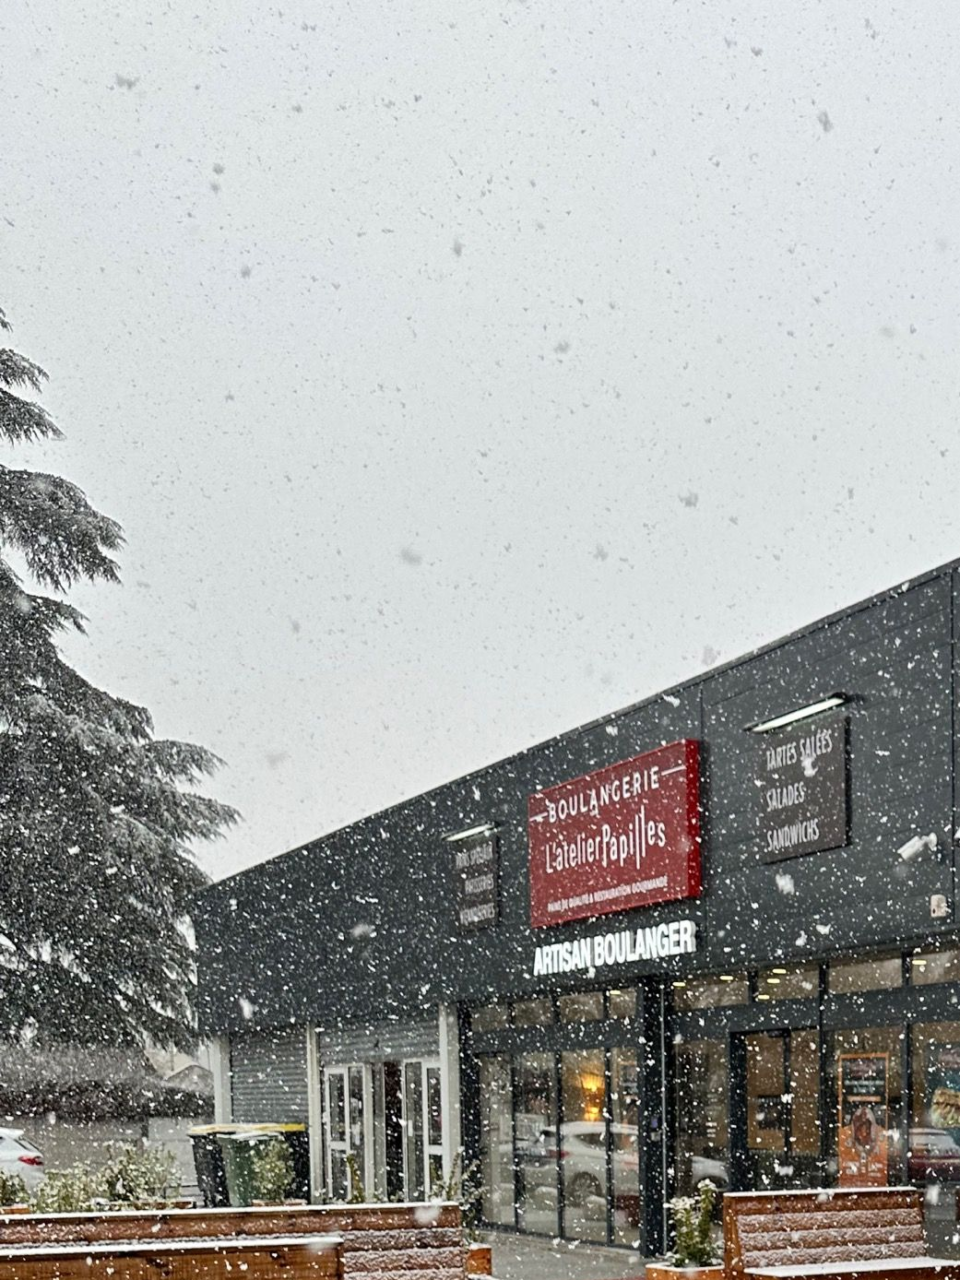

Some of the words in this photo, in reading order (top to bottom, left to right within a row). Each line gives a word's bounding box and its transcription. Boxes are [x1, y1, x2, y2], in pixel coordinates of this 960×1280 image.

[766, 741, 797, 771] TARTES
[800, 728, 833, 761] SALÉES
[547, 766, 660, 823] BOULANGERIE
[766, 781, 805, 812] SALADES
[533, 937, 591, 976] ARTISAN
[594, 920, 697, 966] BOULANGER
